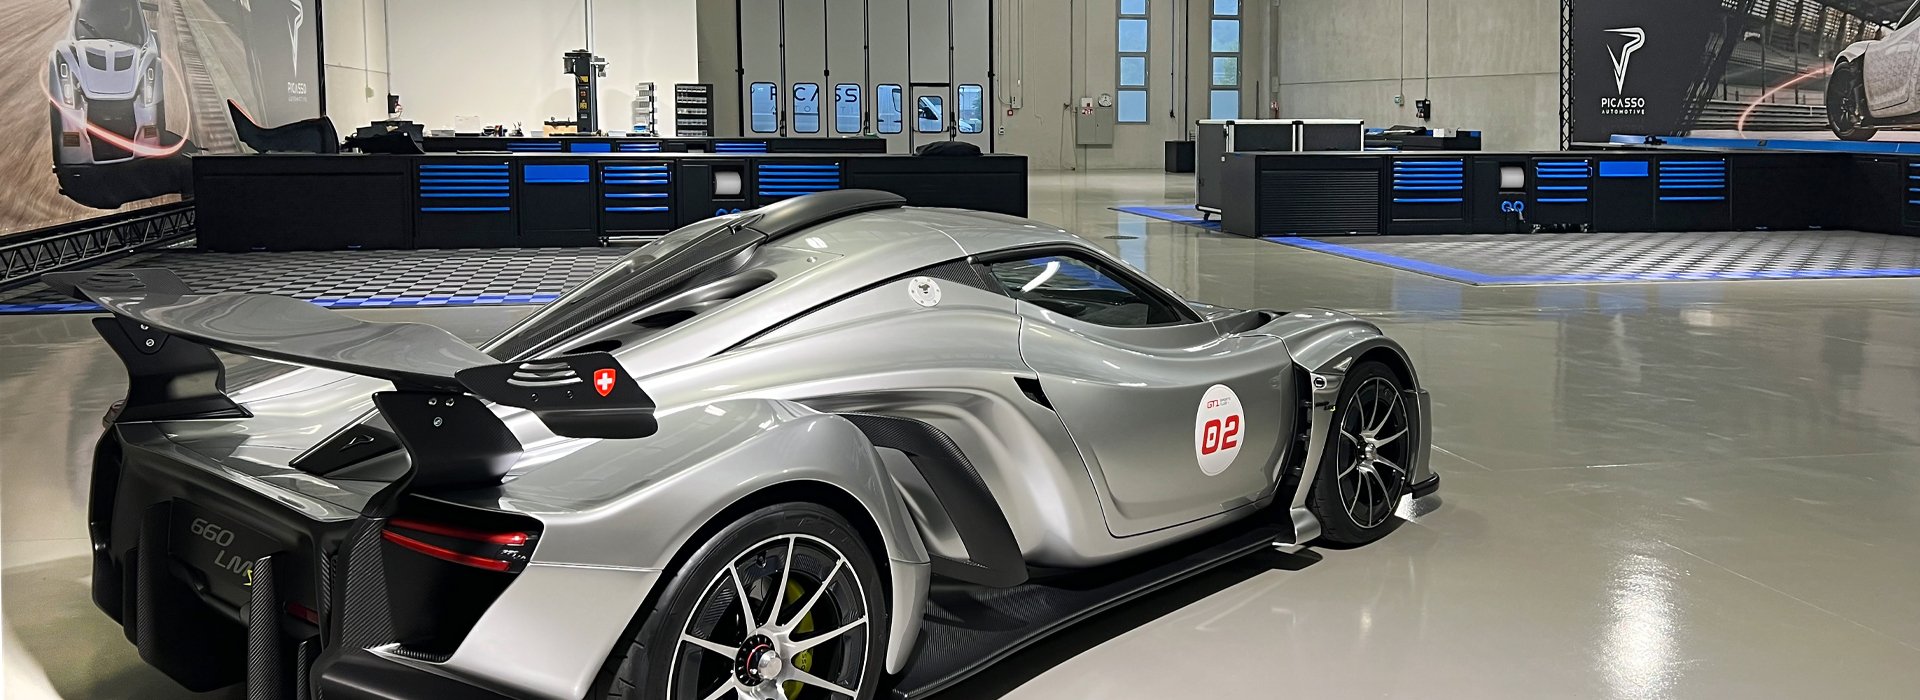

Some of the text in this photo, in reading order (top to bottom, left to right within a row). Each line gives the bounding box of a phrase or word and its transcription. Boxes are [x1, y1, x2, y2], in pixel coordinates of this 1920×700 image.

[1601, 97, 1645, 108] PICASSO
[1201, 414, 1240, 456] 02
[190, 517, 236, 547] 660
